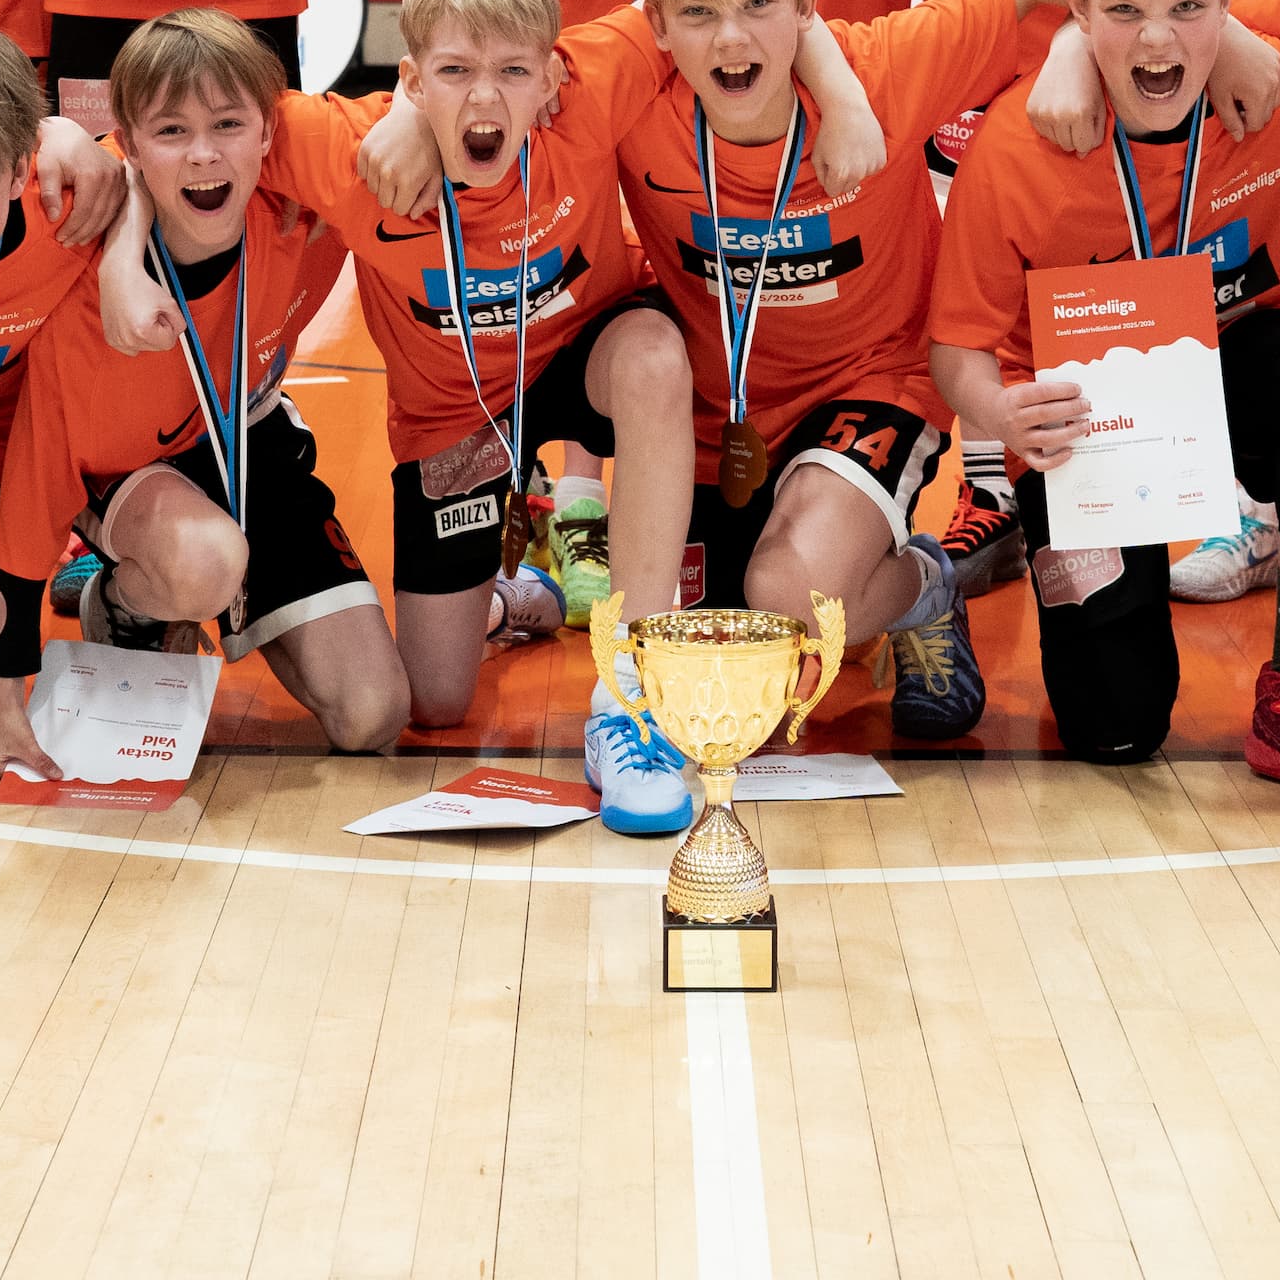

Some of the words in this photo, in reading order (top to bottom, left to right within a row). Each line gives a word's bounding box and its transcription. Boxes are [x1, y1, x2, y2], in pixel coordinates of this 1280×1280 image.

[63, 95, 111, 110] estov
[720, 225, 804, 251] Eesti
[1053, 299, 1137, 320] Noorteliiga
[1084, 414, 1135, 437] jusalu
[821, 411, 899, 472] 54
[440, 500, 491, 532] BALLZY
[142, 735, 177, 748] Vald
[117, 746, 173, 761] Gustav
